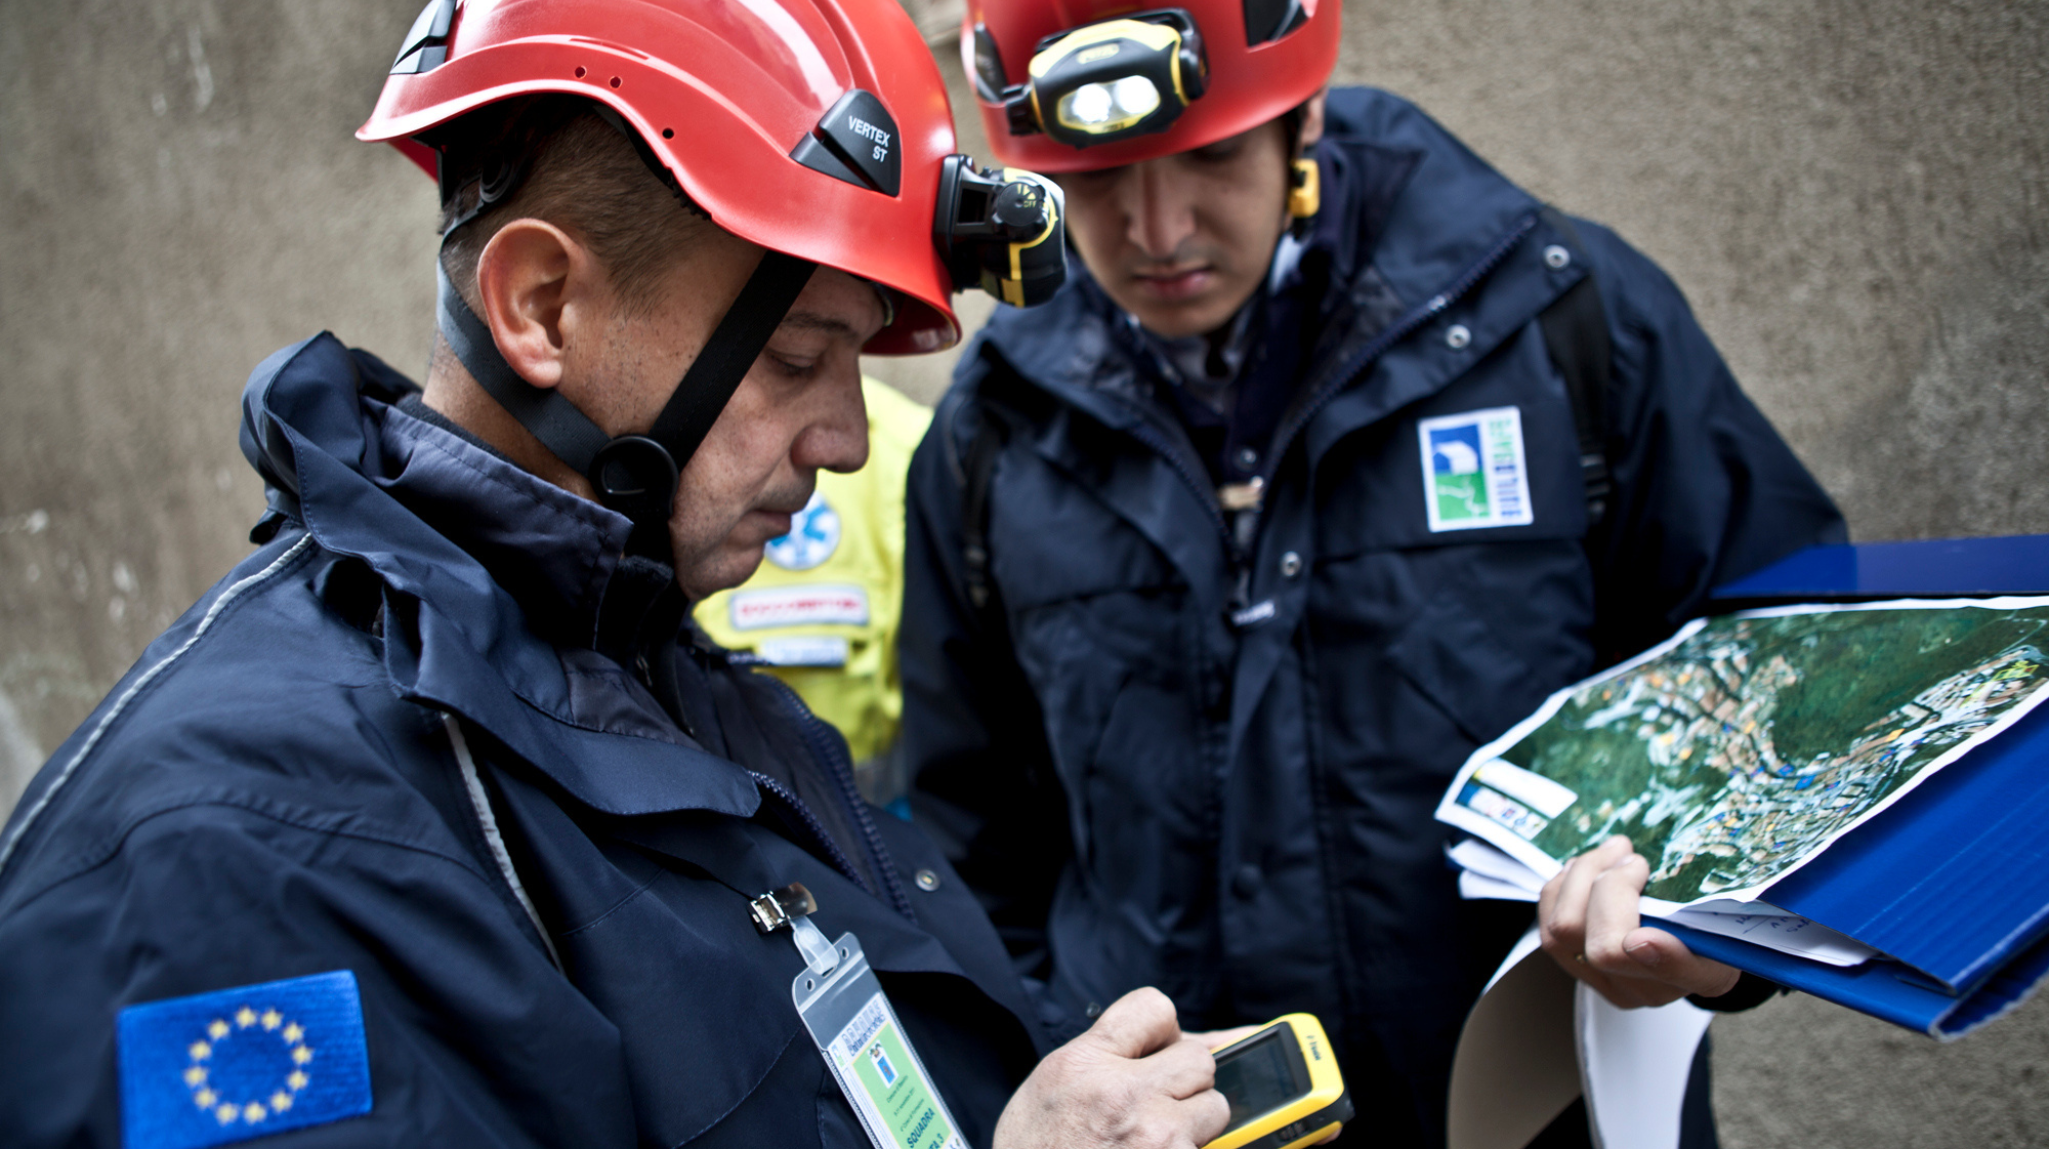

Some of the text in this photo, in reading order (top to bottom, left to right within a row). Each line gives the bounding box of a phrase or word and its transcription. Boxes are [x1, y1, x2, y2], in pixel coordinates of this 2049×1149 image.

[848, 115, 891, 147] VERTEX
[872, 145, 888, 163] ST
[907, 1107, 935, 1149] SQUADRA
